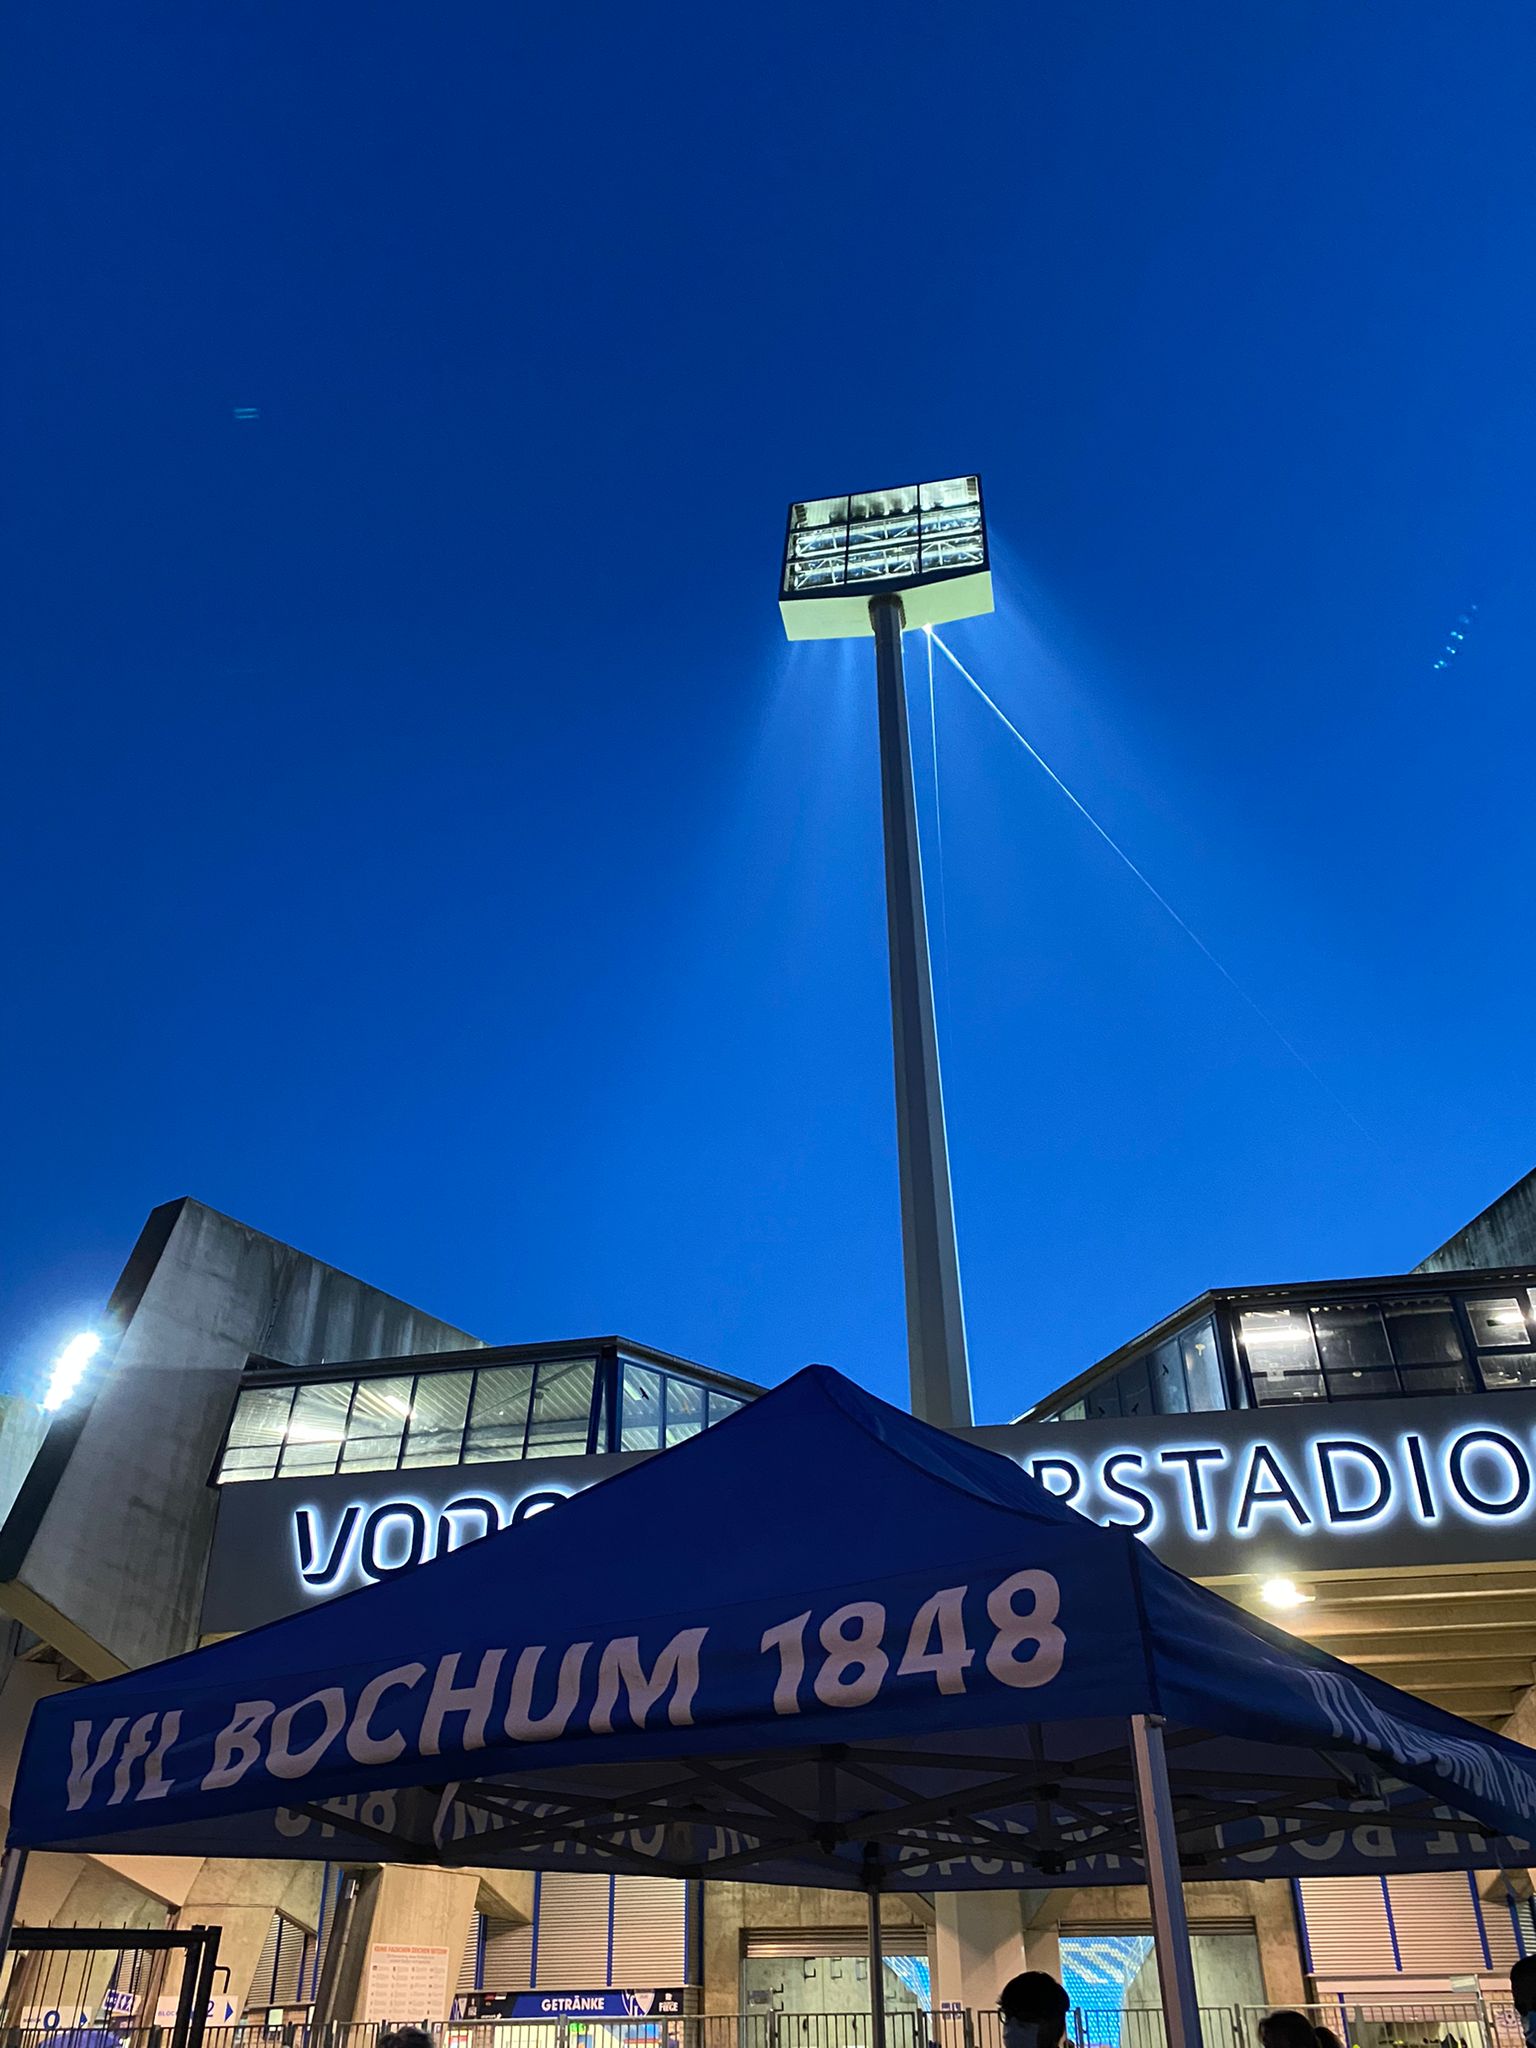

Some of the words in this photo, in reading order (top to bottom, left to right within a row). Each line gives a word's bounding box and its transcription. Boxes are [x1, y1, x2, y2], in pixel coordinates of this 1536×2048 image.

[66, 1709, 184, 1812] VfL
[200, 1627, 710, 1791] BOCHUM
[761, 1568, 1067, 1715] 1848
[541, 1995, 605, 2012] GETRÄNKE
